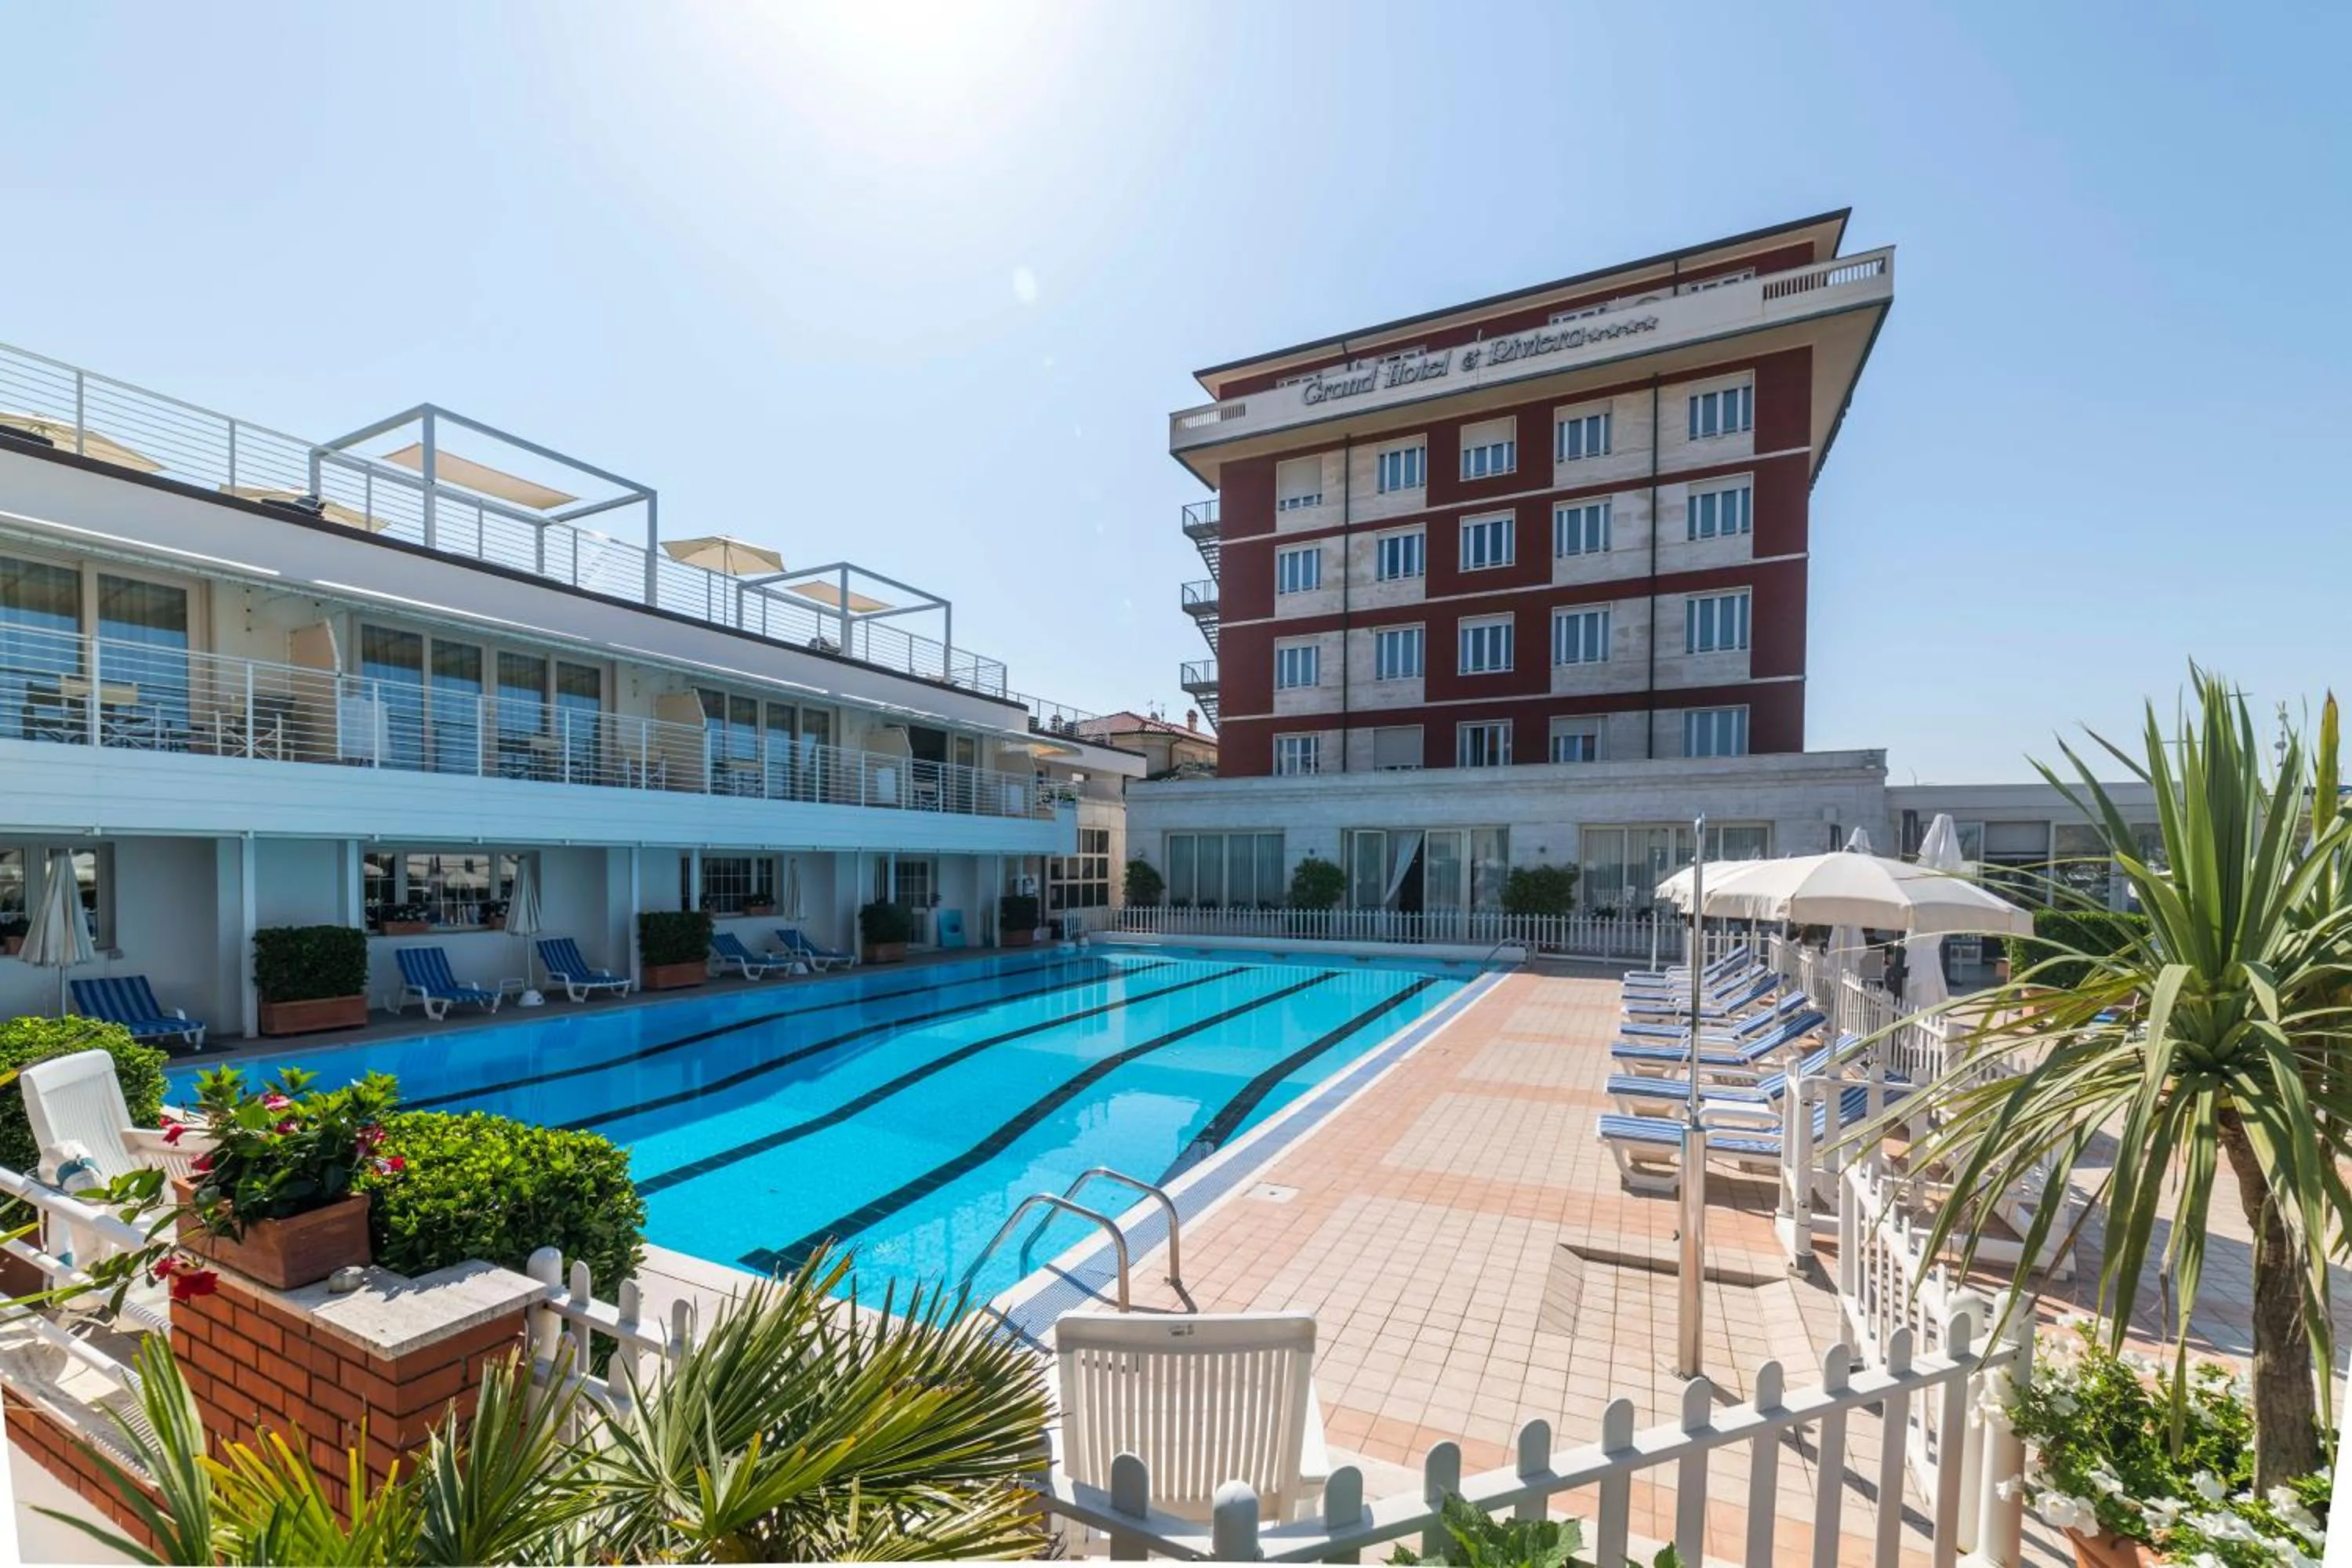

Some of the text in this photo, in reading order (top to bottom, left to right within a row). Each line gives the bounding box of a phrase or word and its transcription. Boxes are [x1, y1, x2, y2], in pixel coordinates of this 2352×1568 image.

[1303, 327, 1585, 405] Grand Hotel & Riviera
